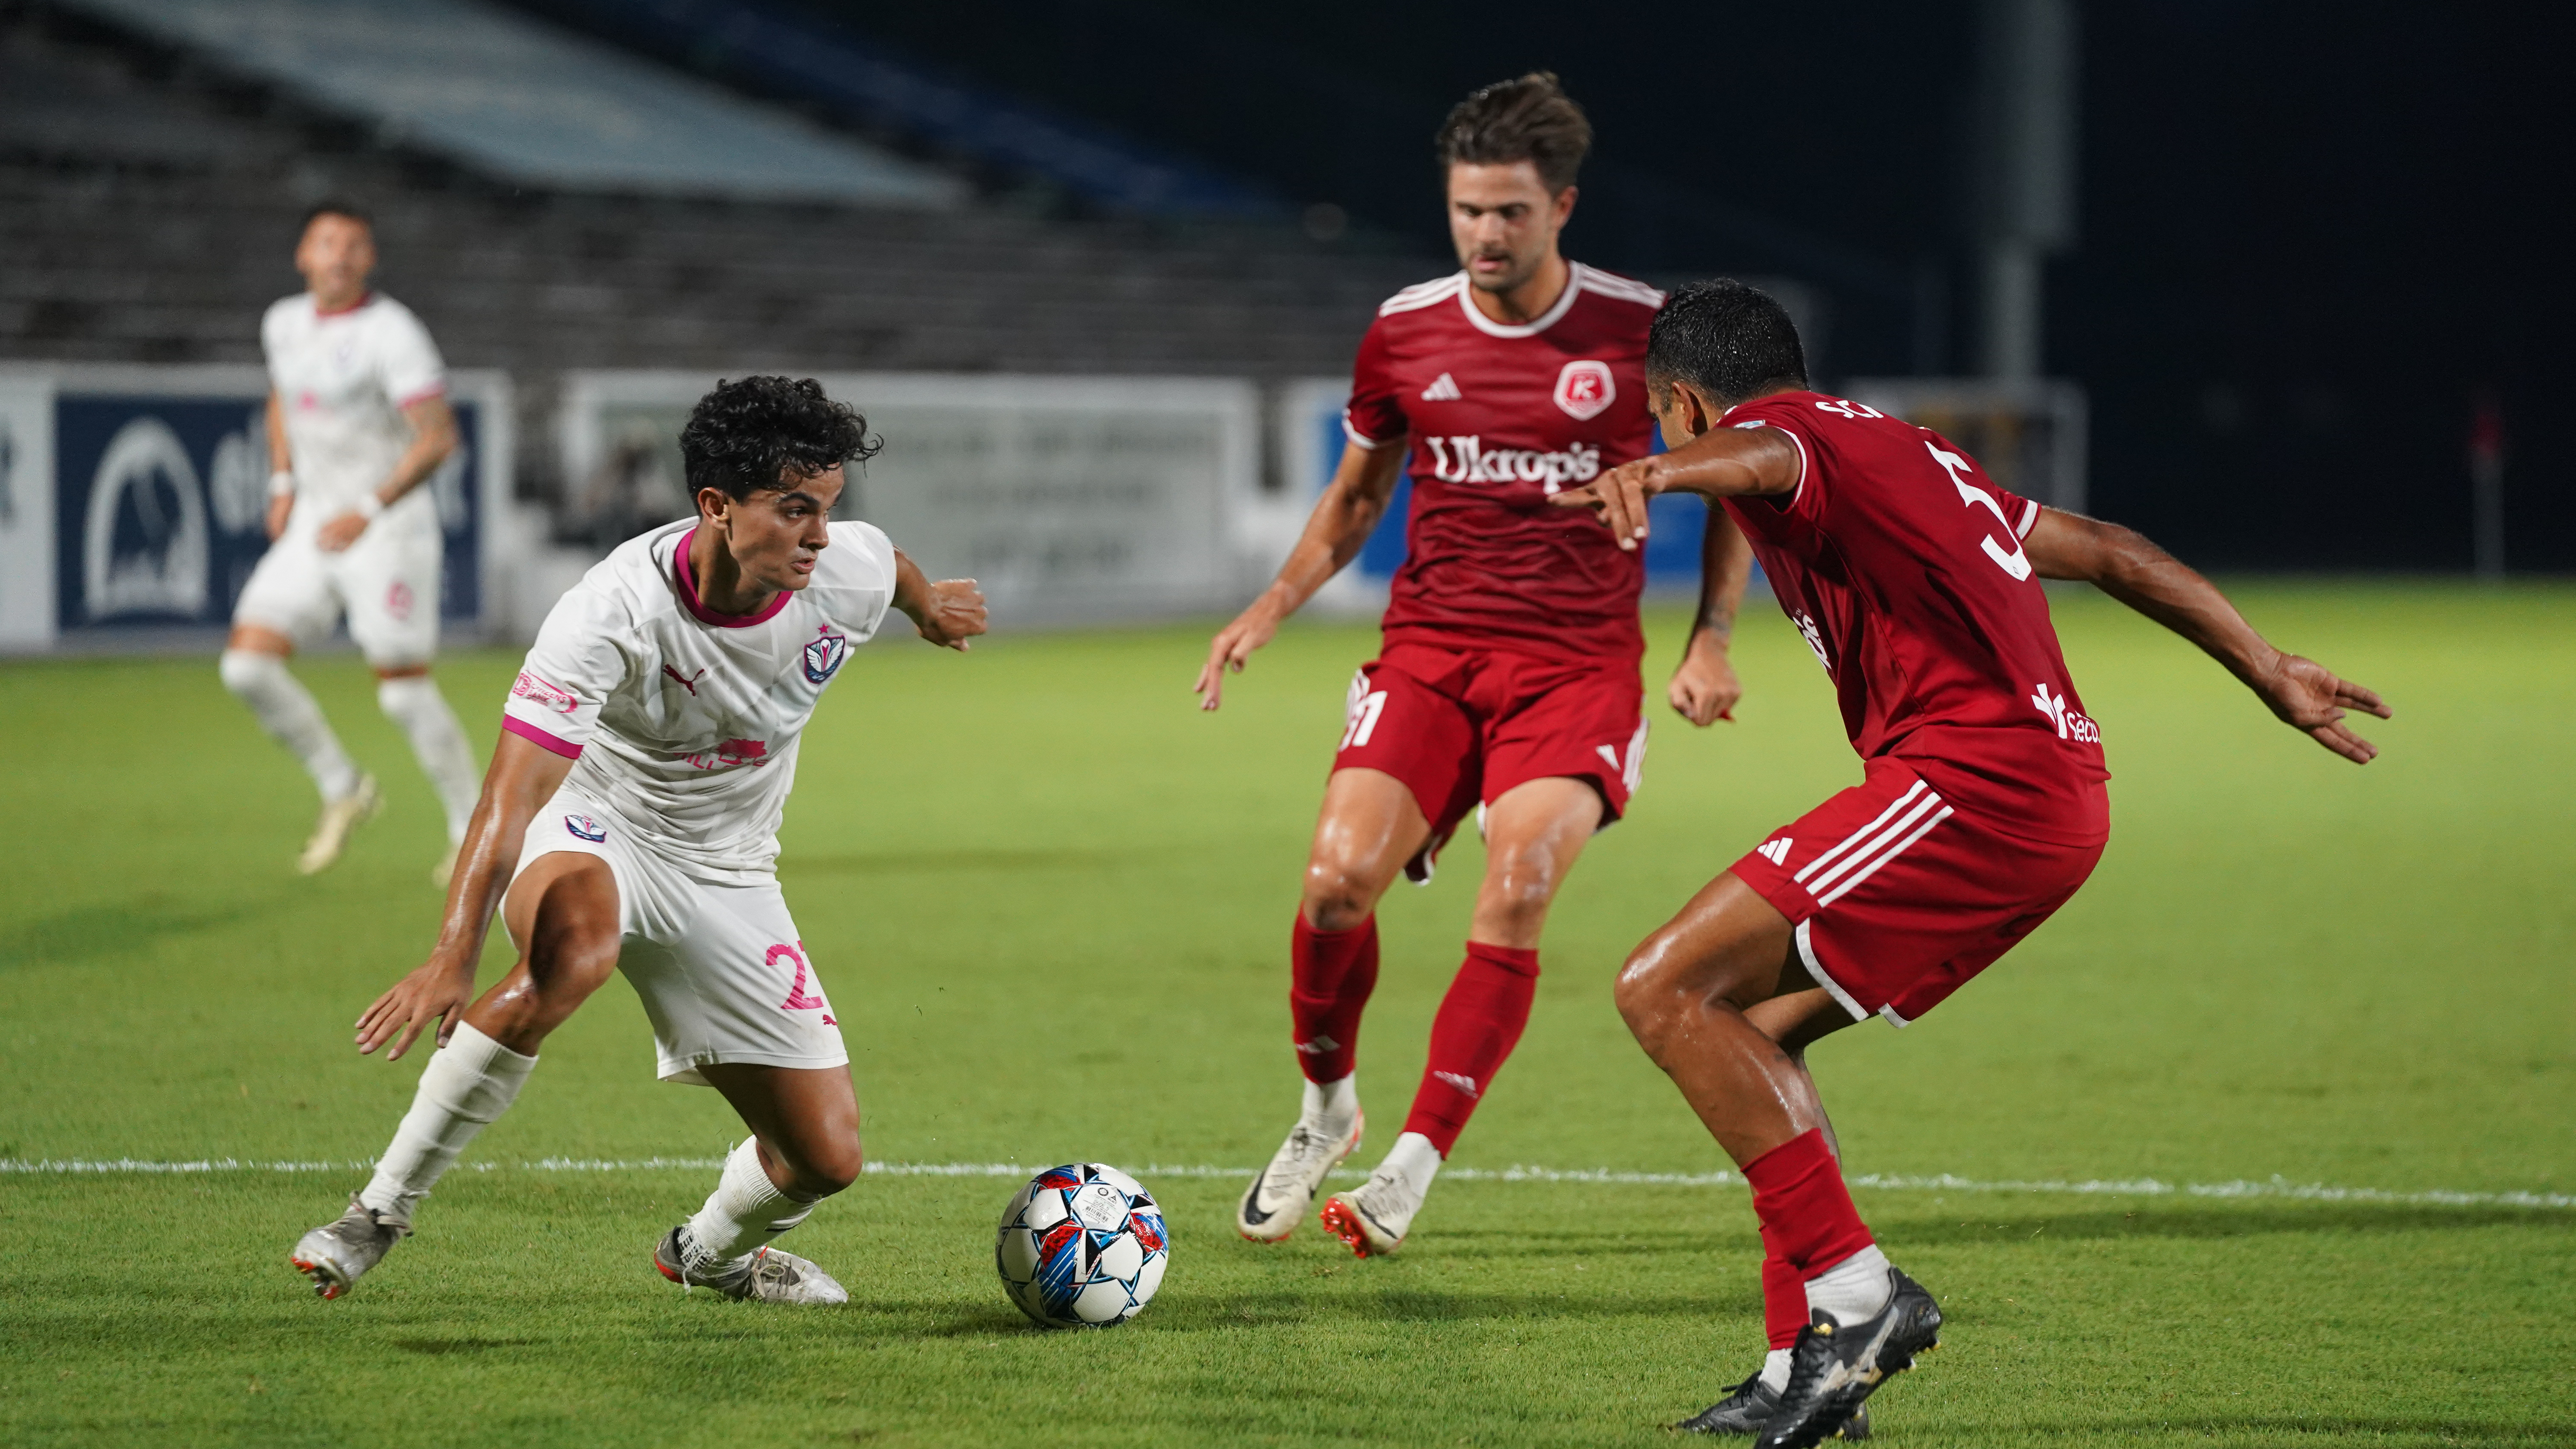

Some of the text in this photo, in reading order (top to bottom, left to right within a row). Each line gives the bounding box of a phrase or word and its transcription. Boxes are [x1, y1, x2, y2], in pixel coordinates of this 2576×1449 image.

[1425, 435, 1601, 494] Ukrop's
[1924, 440, 2032, 582] 5
[2066, 712, 2101, 743] Seco
